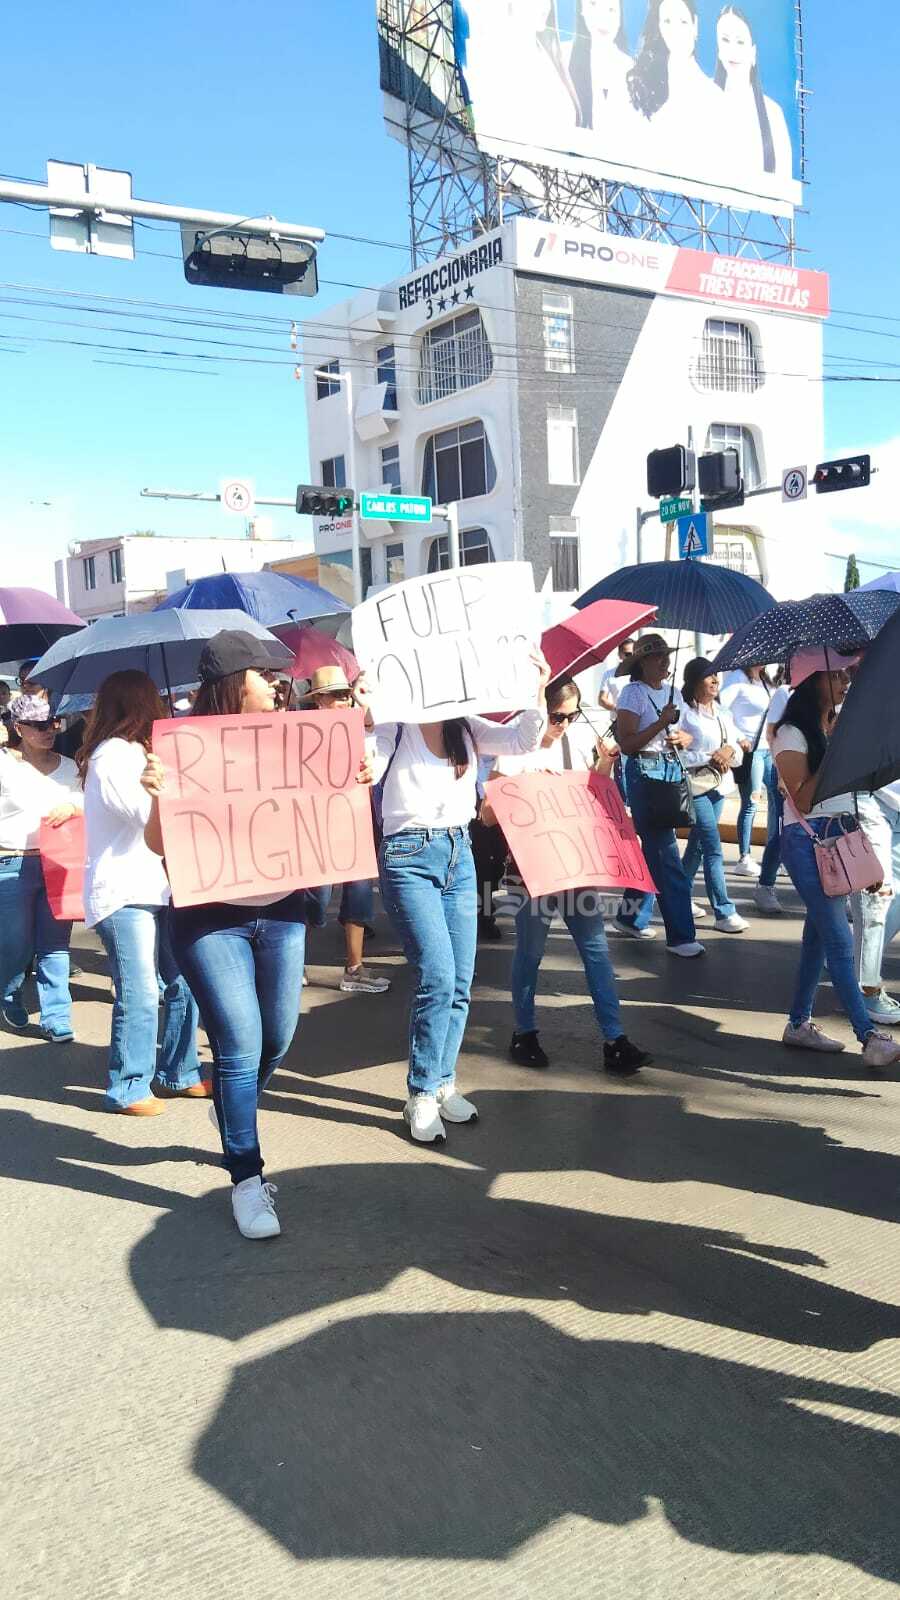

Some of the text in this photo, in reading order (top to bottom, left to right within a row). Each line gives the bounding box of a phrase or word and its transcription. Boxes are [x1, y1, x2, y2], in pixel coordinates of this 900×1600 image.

[399, 237, 502, 310] REFACCIONARIA
[699, 273, 810, 309] TRES ESTRELLAS
[425, 299, 433, 320] 3
[367, 501, 397, 512] CARLOS
[661, 505, 669, 516] 20
[161, 720, 352, 798] RETIRO
[174, 792, 357, 894] DIGNO
